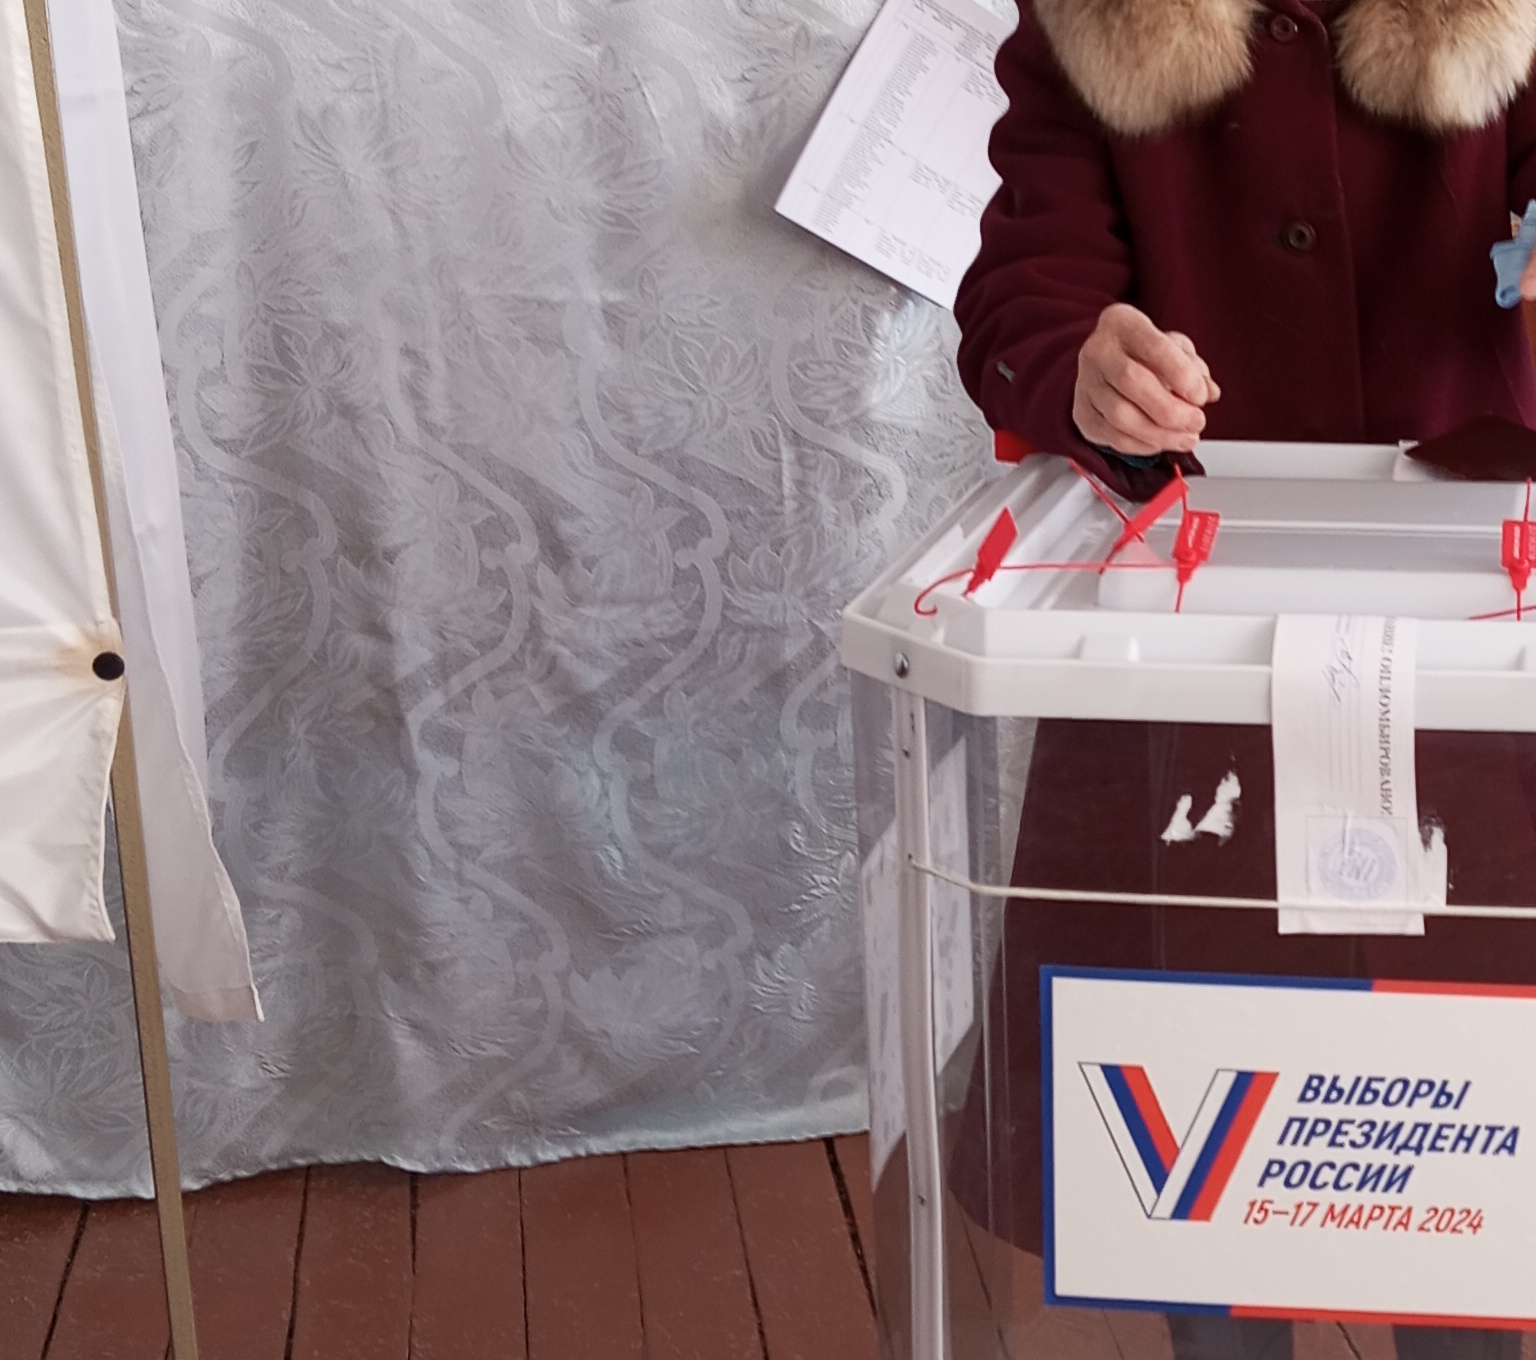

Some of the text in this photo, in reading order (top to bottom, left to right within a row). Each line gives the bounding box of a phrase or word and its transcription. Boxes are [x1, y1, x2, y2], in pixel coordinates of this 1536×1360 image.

[1297, 1073, 1472, 1111] ВЫБОРЫ
[1276, 1116, 1521, 1156] ПРЕЗИДЕНТА
[1257, 1158, 1415, 1194] РОССИИ
[1319, 1202, 1414, 1232] МАРТА
[1416, 1206, 1485, 1236] 2024
